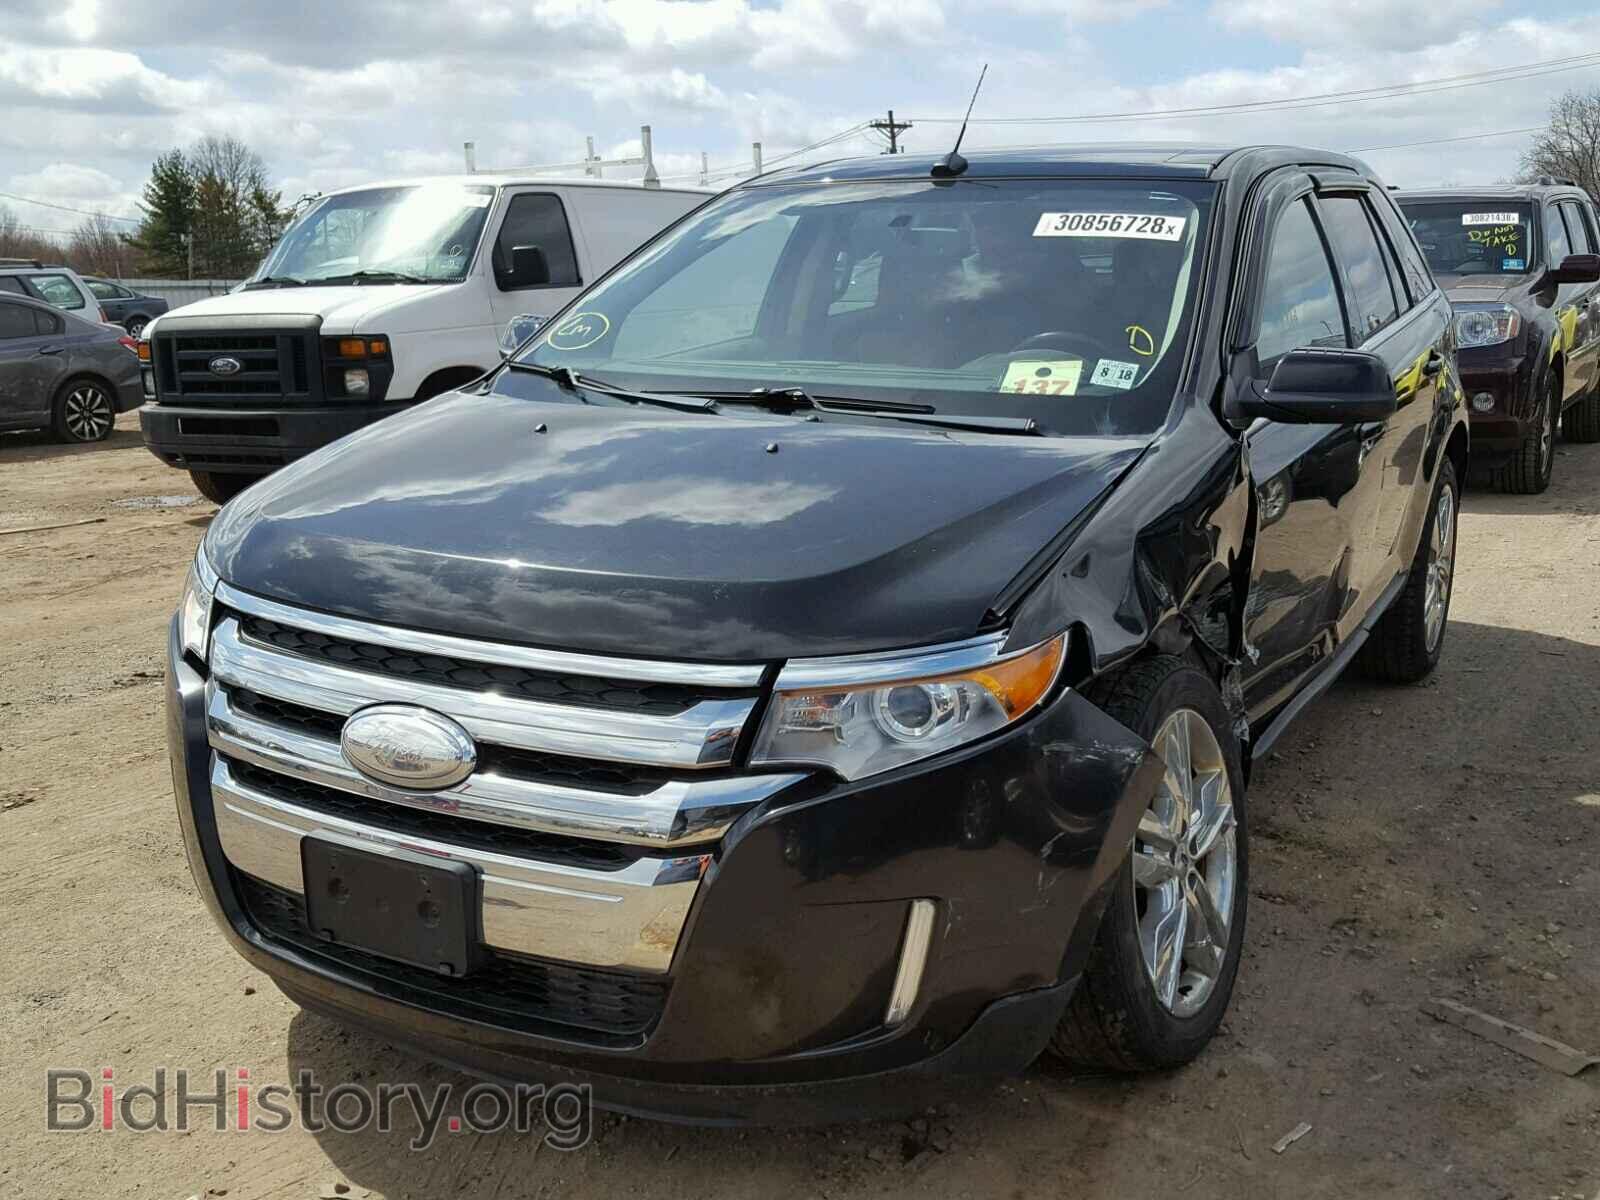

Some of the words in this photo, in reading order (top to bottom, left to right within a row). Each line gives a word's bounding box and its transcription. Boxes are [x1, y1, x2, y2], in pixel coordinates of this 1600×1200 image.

[1480, 231, 1521, 247] TAKE
[1125, 325, 1154, 356] D
[1100, 366, 1110, 378] 8
[1117, 368, 1133, 381] 18
[1014, 378, 1071, 396] 137
